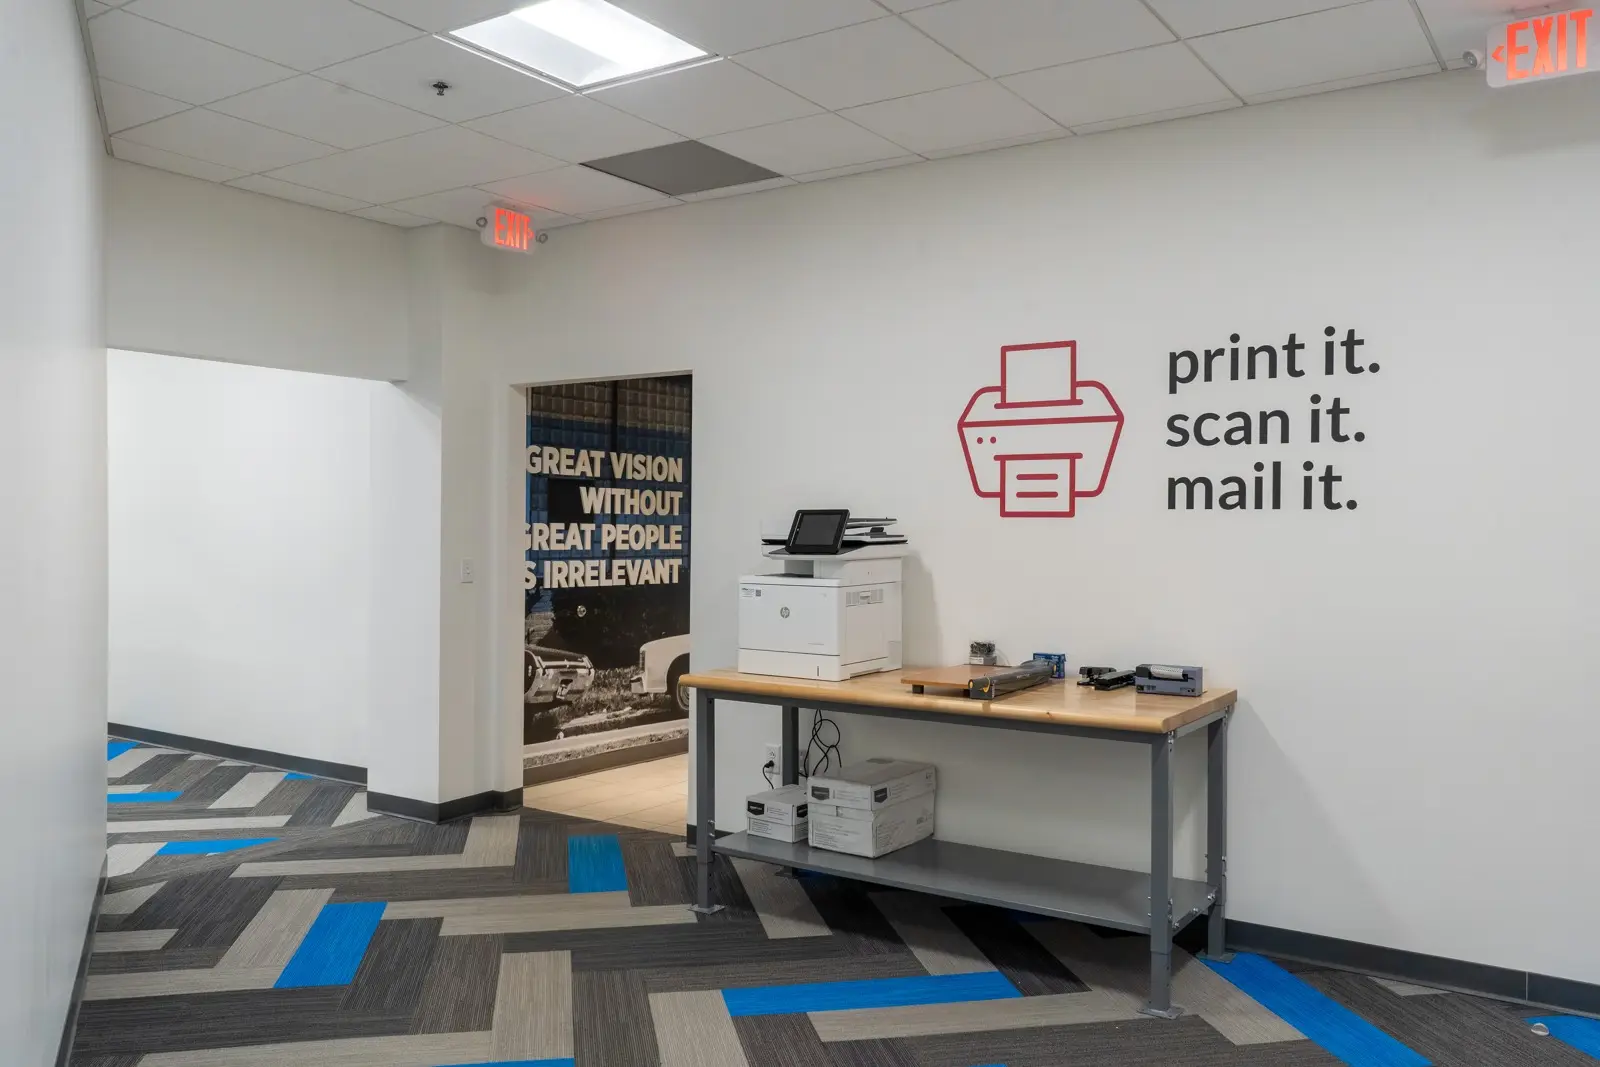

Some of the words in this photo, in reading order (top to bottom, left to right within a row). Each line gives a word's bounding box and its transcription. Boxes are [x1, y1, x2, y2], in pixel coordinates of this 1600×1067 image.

[1506, 8, 1592, 80] EXIT
[495, 208, 530, 250] EXIT
[1168, 332, 1306, 395] print
[1323, 325, 1381, 376] it.
[1166, 409, 1291, 448] scan
[1309, 393, 1366, 444] it.
[526, 445, 605, 478] GREAT
[609, 451, 683, 483] VISION
[579, 486, 683, 516] WITHOUT
[1167, 460, 1282, 511] mail
[1302, 460, 1358, 511] it.
[601, 524, 683, 551] PEOPLE
[543, 559, 683, 589] IRRELEVANT
